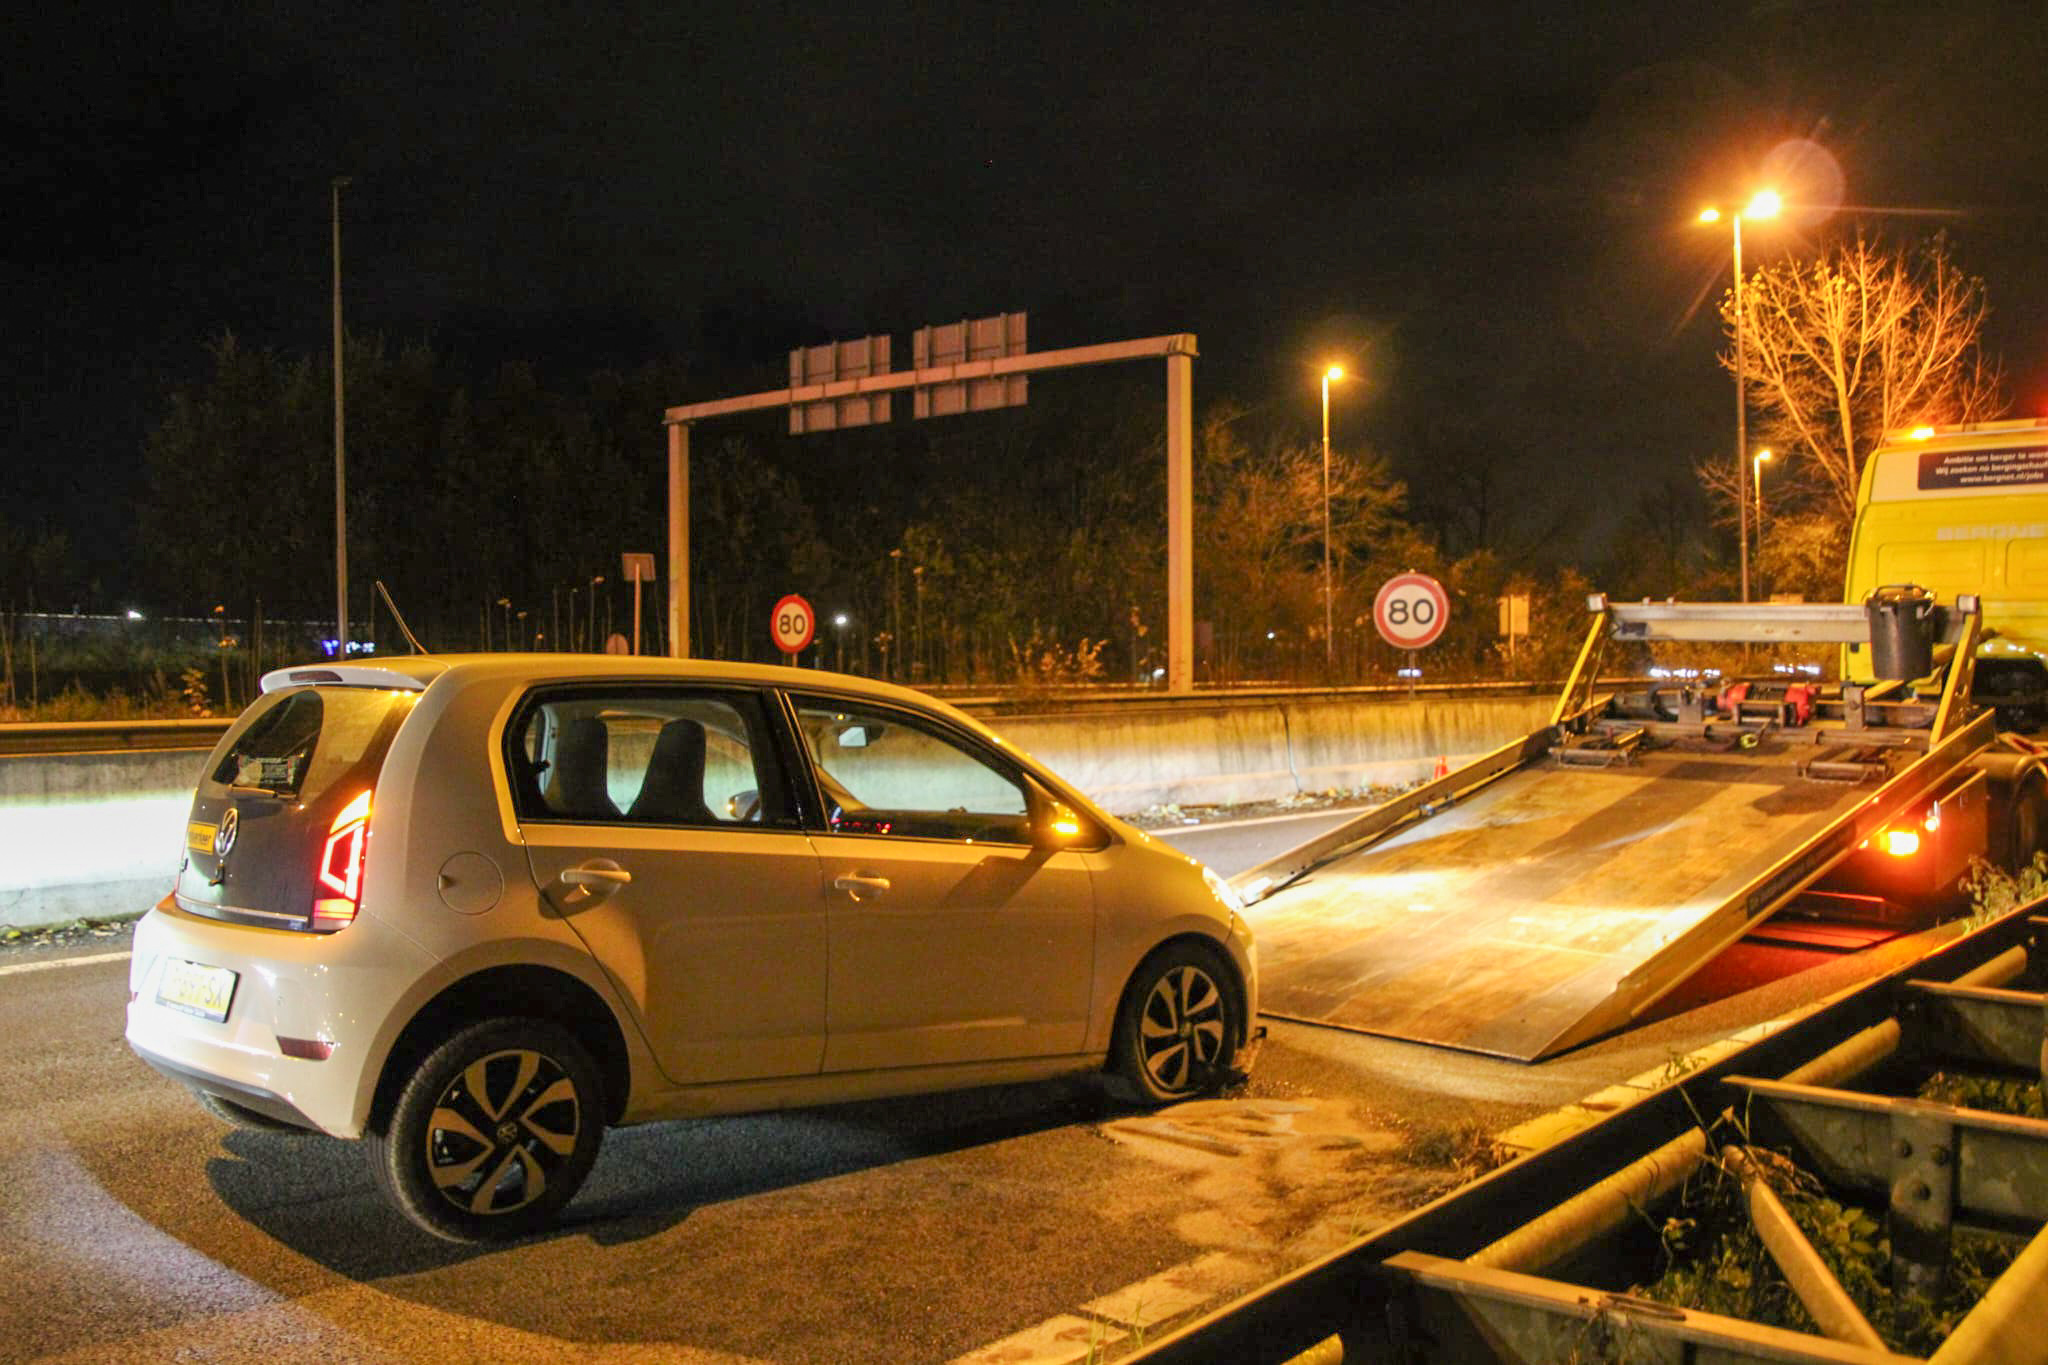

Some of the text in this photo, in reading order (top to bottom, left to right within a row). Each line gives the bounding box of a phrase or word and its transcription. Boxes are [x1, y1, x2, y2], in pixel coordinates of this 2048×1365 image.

[1943, 455, 1974, 464] Ambitie
[1975, 455, 1989, 463] om
[1990, 453, 2016, 462] berger
[2018, 452, 2027, 460] te
[1935, 466, 1949, 476] Wij
[1950, 465, 1978, 475] zoeken
[1960, 471, 2044, 483] www.bergnet.nl/jobs
[1388, 598, 1434, 625] 80
[779, 613, 806, 635] 80
